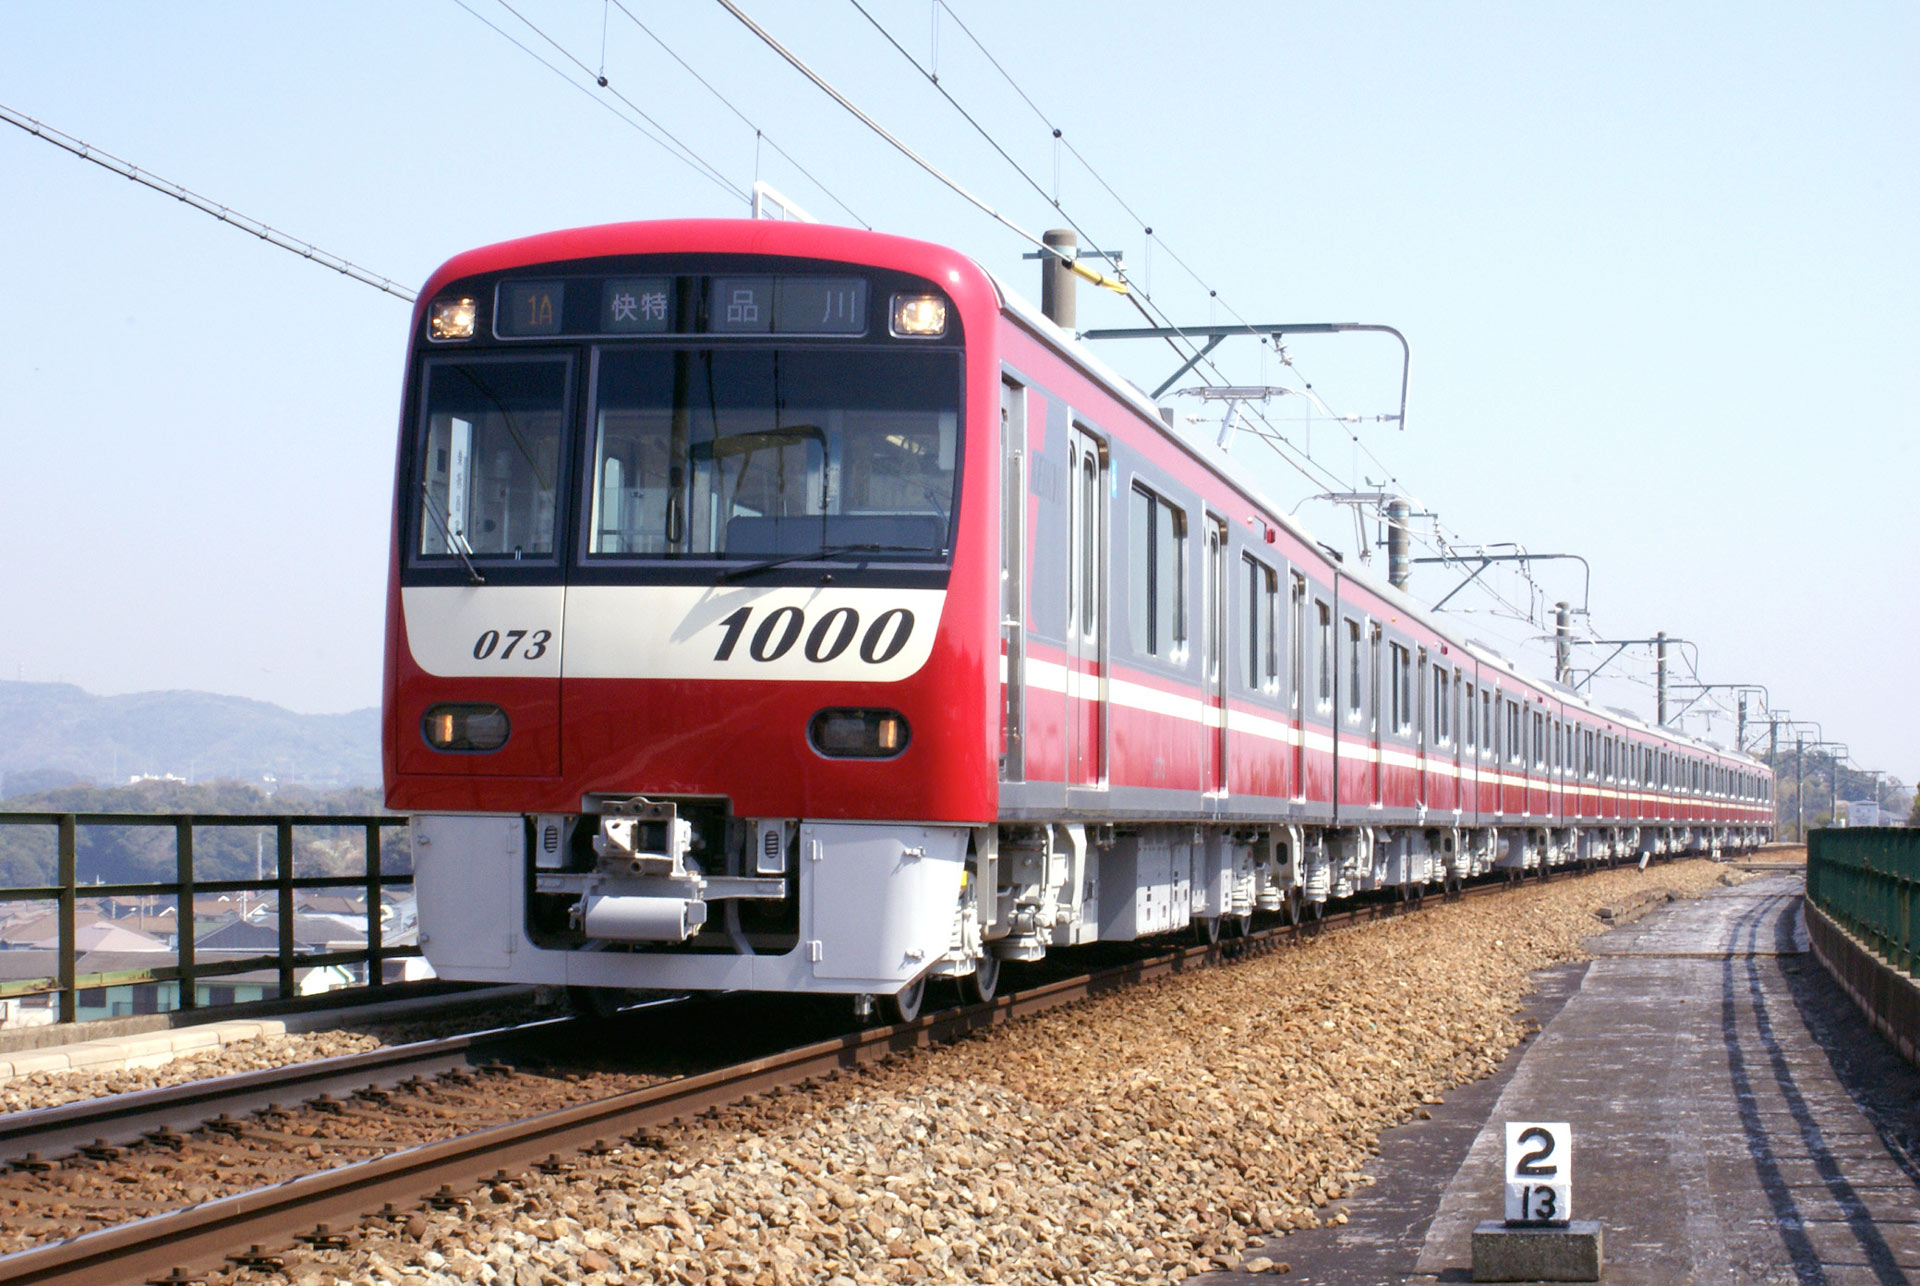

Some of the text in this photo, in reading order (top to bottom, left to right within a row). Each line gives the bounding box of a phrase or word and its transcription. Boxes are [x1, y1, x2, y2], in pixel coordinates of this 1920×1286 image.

[528, 294, 553, 325] 1A
[611, 292, 667, 322] 快特
[473, 630, 553, 660] 073
[713, 606, 916, 665] 1000
[1516, 1126, 1558, 1176] 2
[1522, 1185, 1556, 1219] 13
